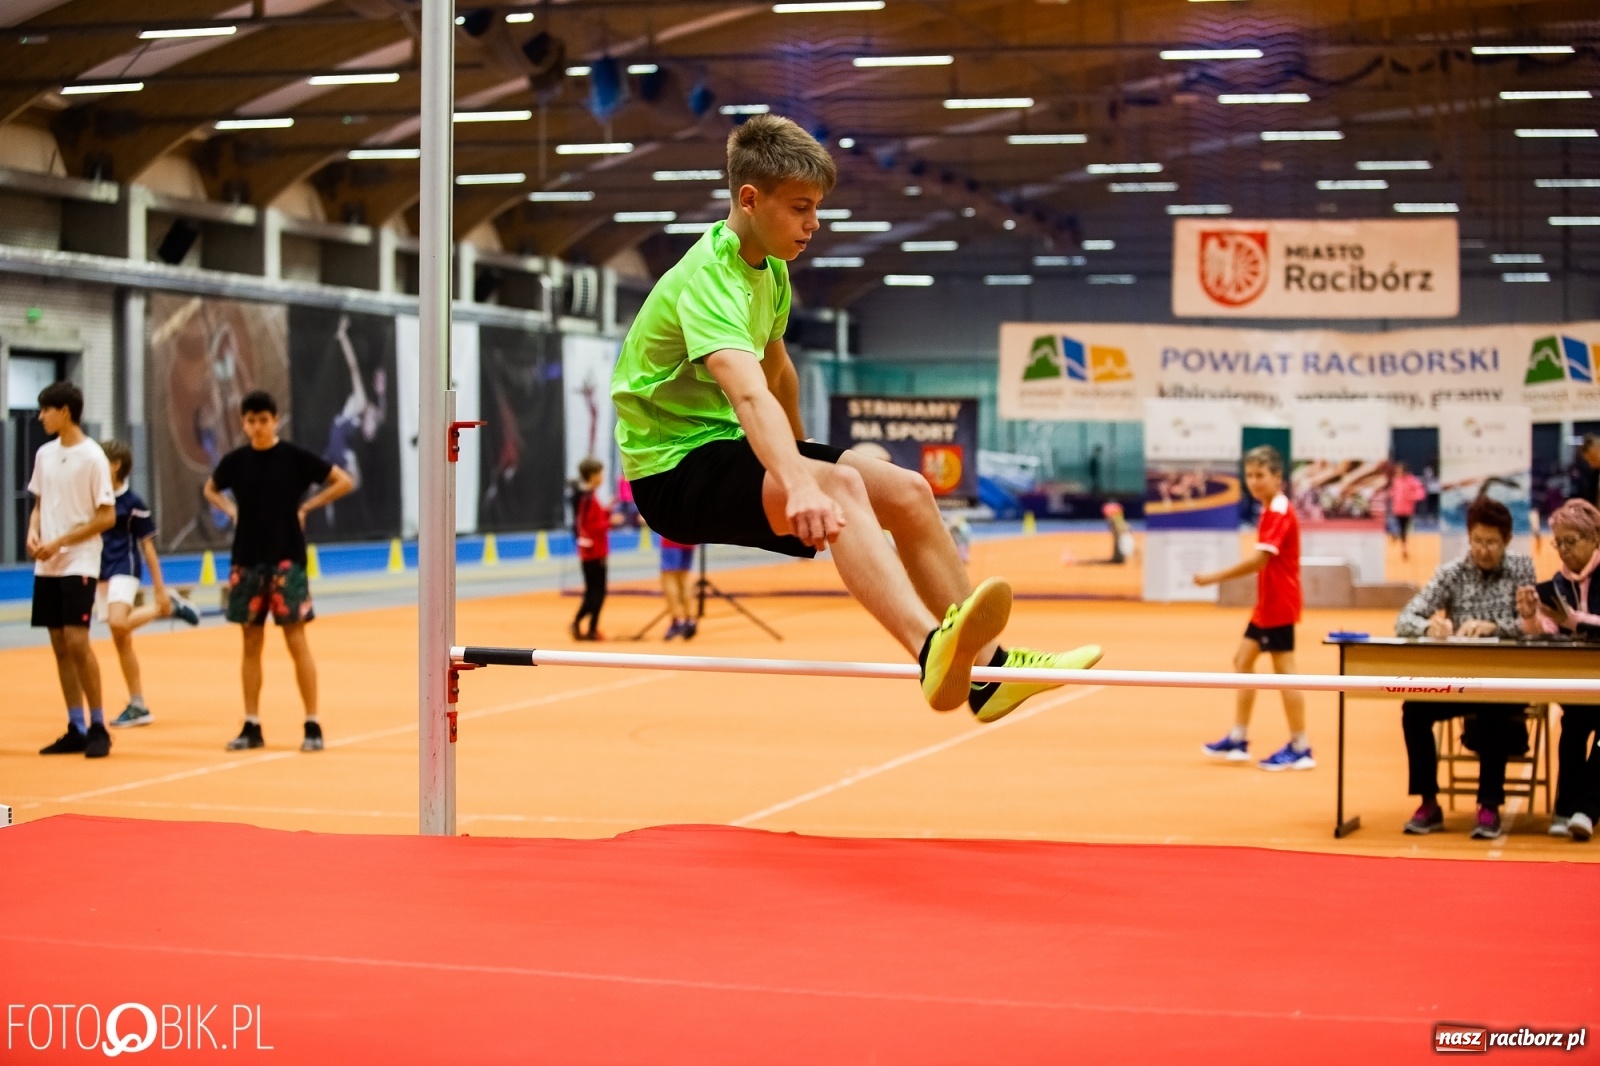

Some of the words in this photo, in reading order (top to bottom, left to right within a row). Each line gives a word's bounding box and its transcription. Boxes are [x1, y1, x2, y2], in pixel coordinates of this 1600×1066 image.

[1284, 244, 1364, 261] MIASTO
[1284, 262, 1434, 293] Racibórz
[1160, 348, 1291, 375] POWIAT
[1302, 348, 1500, 376] RACIBORSKI
[847, 399, 961, 419] STAWIAMY
[850, 420, 884, 440] NA
[886, 421, 957, 442] SPORT
